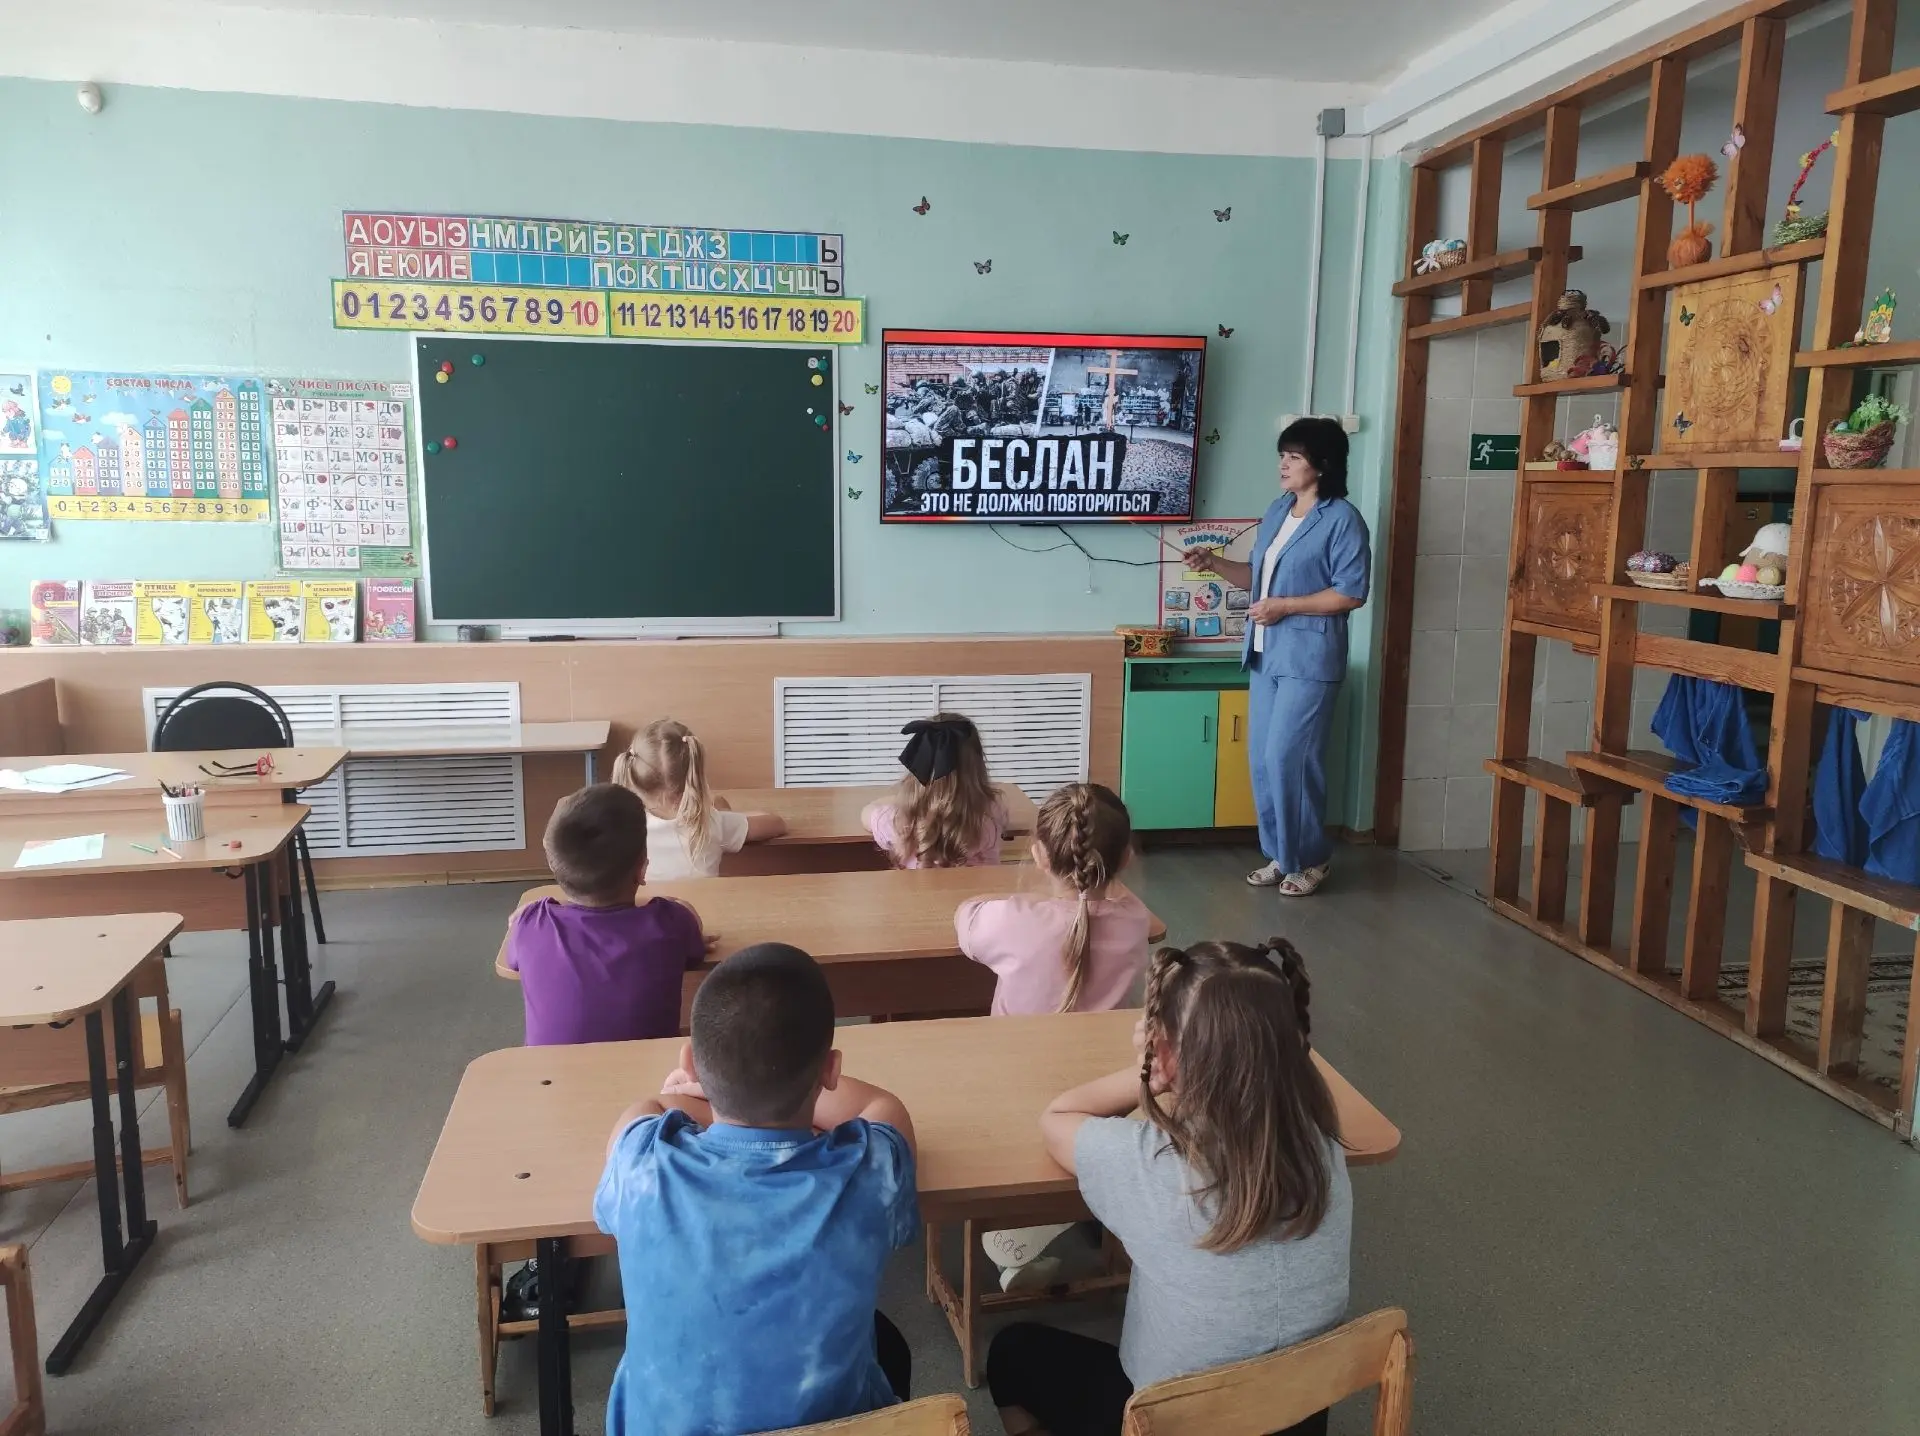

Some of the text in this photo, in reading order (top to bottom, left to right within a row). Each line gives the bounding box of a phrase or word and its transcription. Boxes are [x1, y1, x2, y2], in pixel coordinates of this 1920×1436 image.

[342, 291, 599, 326] 0 1 2 3 4 5 6 7 8 9 10
[618, 302, 855, 333] 11 12 13 14 15 16 17 18 19 20
[106, 378, 192, 390] СОСТАВ ЧИСЛА
[289, 379, 332, 390] УЧИСЬ
[337, 381, 387, 392] ПИСАТЬ
[952, 439, 1114, 490] БЕСЛАН
[58, 501, 248, 514] 0 1 2 3 4 5 6 7 8 9 10
[921, 493, 1151, 514] ЭТО НЕ ДОЛЖНО ПОВТОРИТЬСЯ
[367, 585, 413, 593] ПРОФЕССИИ
